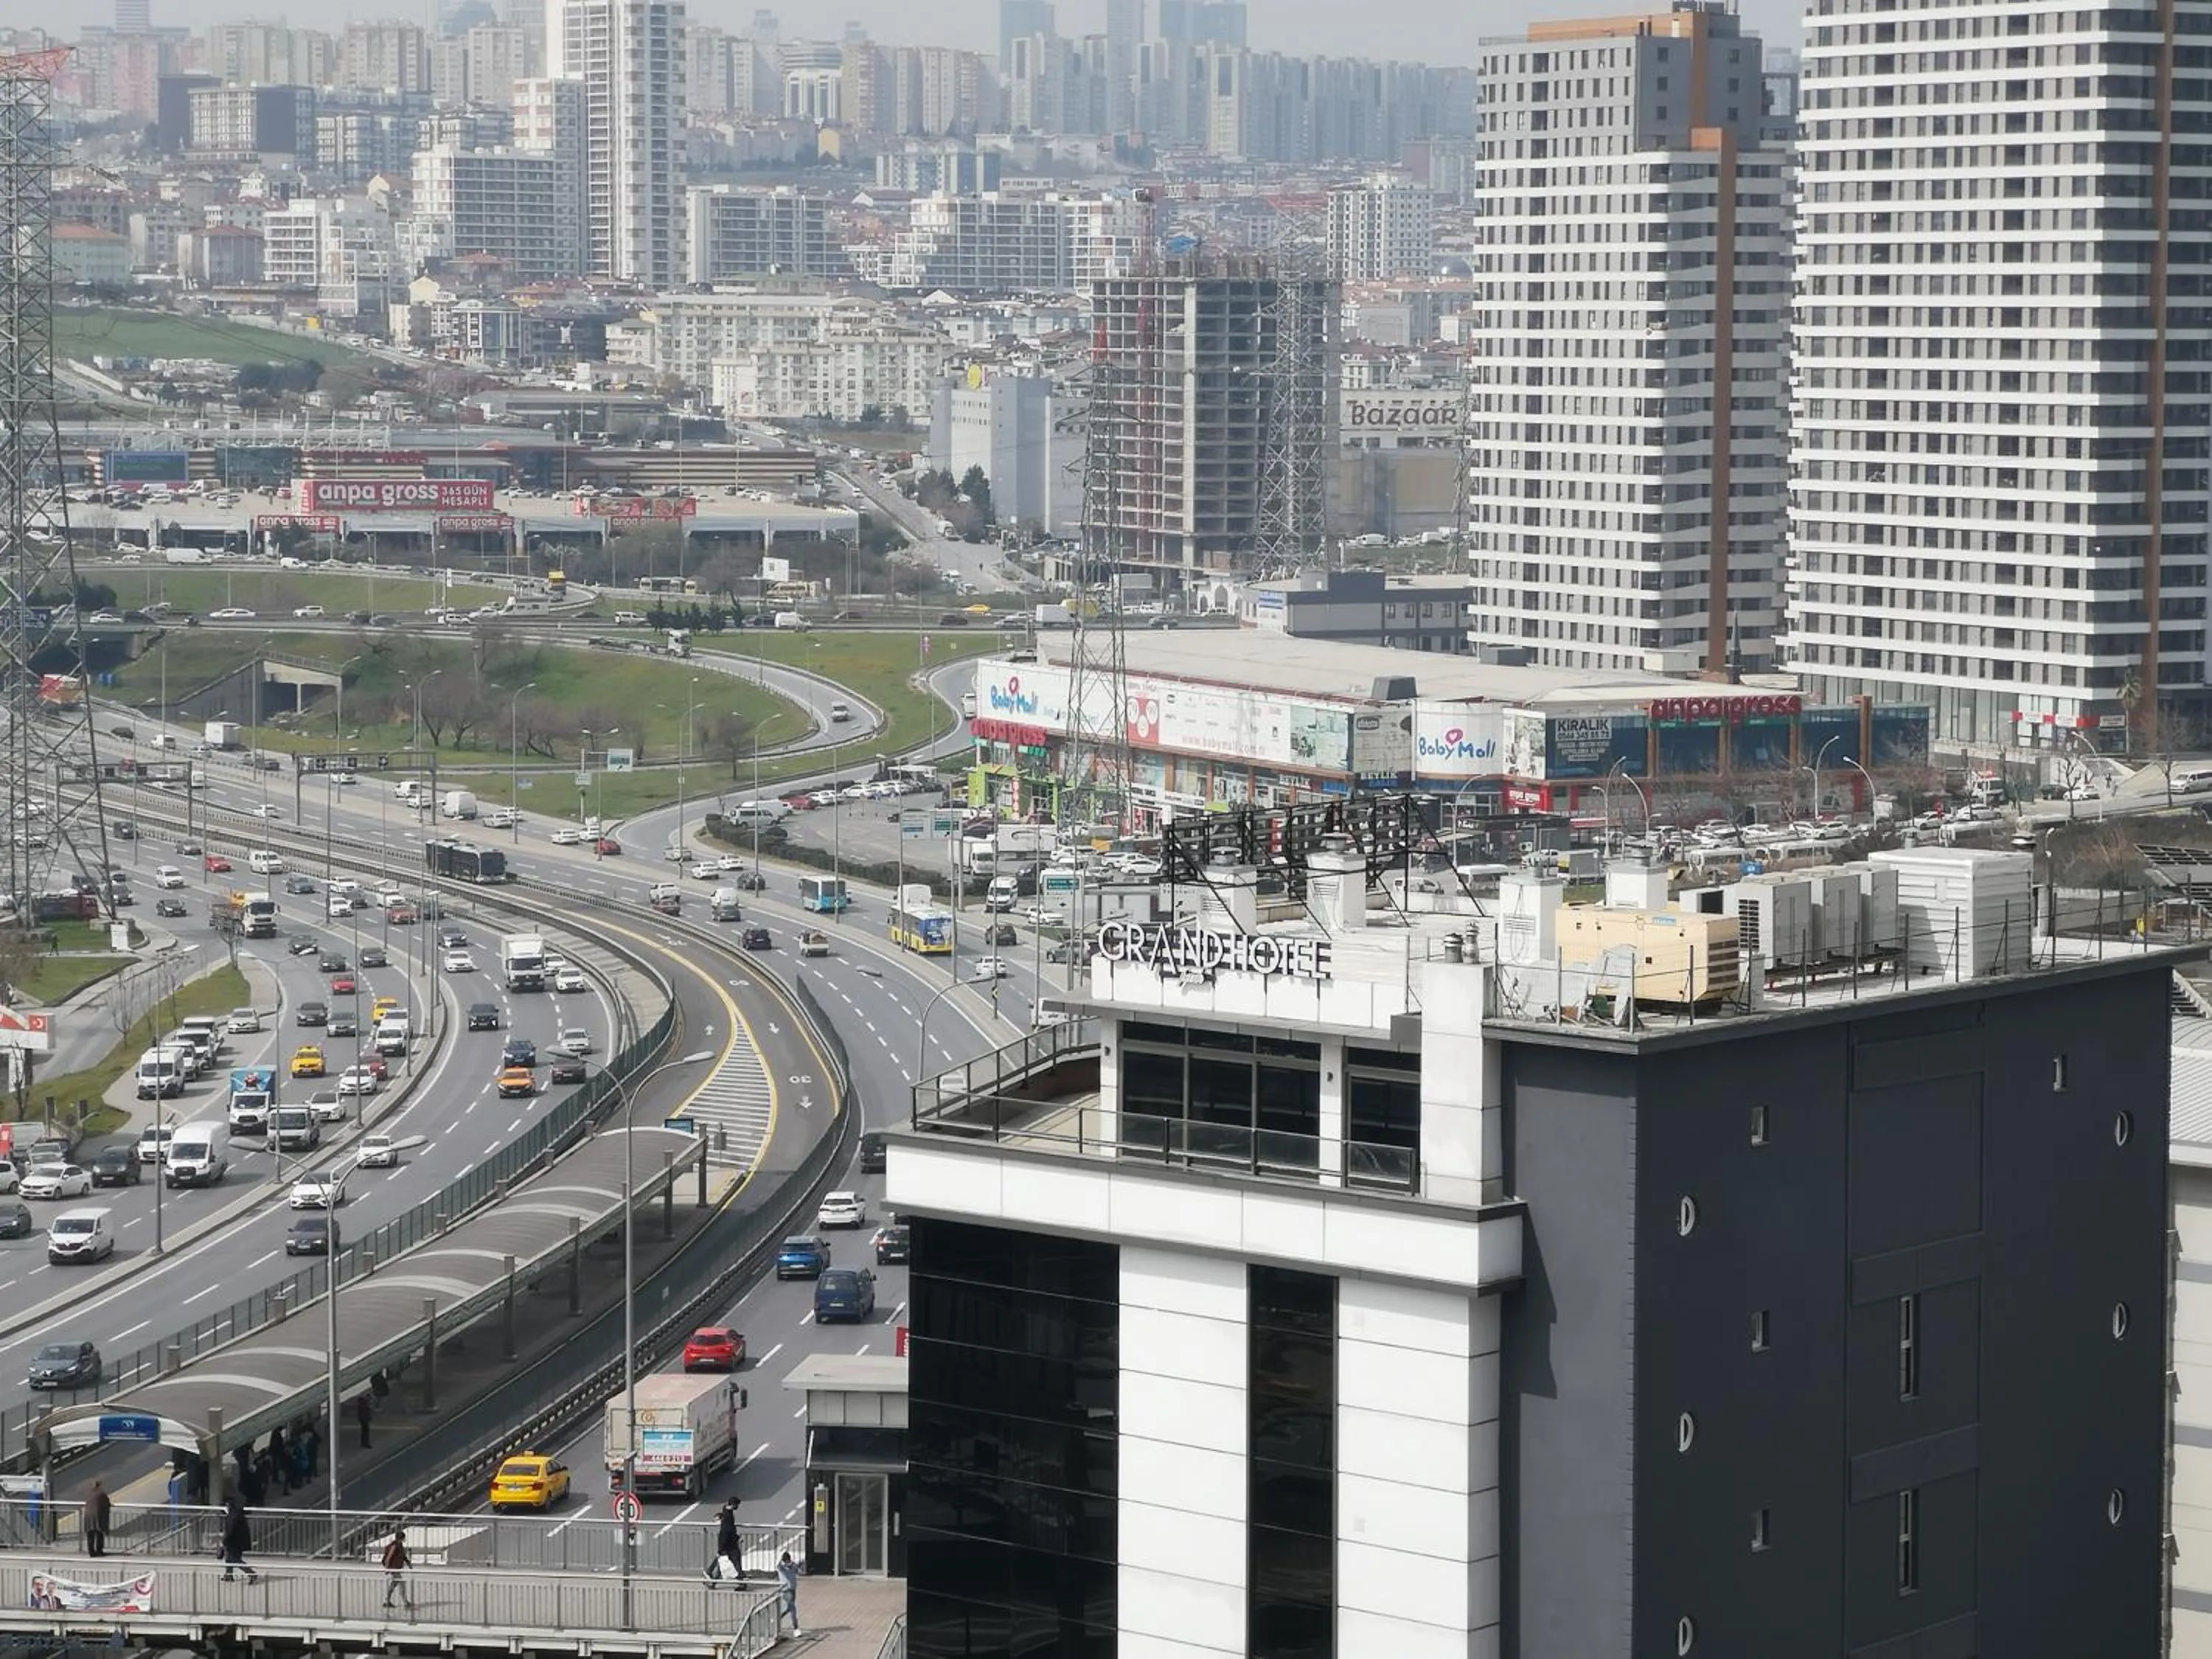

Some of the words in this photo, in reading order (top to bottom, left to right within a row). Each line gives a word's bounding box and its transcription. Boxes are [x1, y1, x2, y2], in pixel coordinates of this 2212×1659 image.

[318, 484, 375, 504] anpa
[381, 484, 439, 507] gross
[442, 487, 461, 495] 365
[463, 484, 487, 495] GÜN
[442, 496, 487, 507] HESAPLI
[442, 518, 468, 528] anpa
[471, 518, 497, 529] gross
[1419, 737, 1454, 759] Baby
[1458, 738, 1496, 758] Mall
[1099, 921, 1224, 975] GRAND
